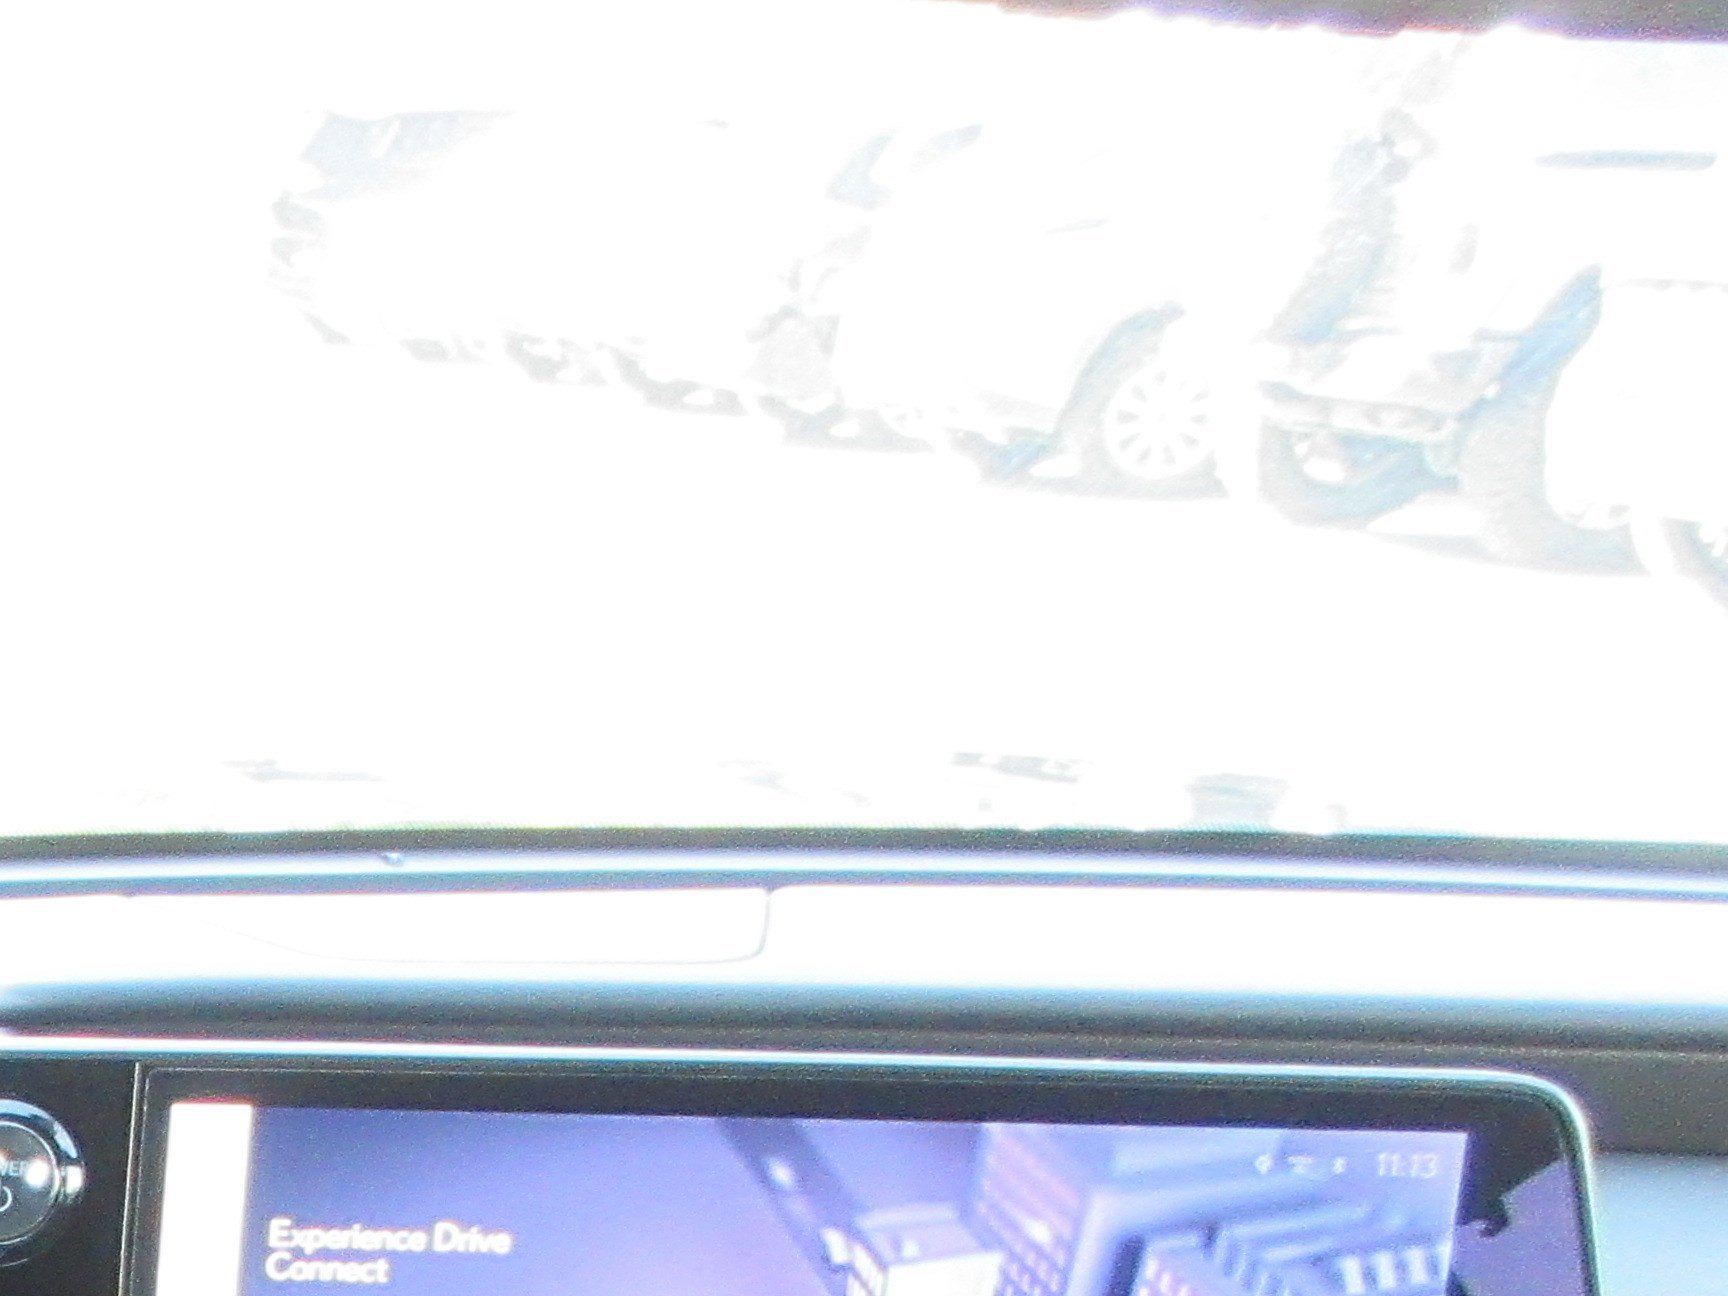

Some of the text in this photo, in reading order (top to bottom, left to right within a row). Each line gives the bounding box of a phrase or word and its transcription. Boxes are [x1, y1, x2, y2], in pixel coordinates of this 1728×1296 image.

[1378, 1153, 1438, 1178] 11:13
[268, 1217, 512, 1254] Experience Drive
[265, 1252, 389, 1283] Connect
